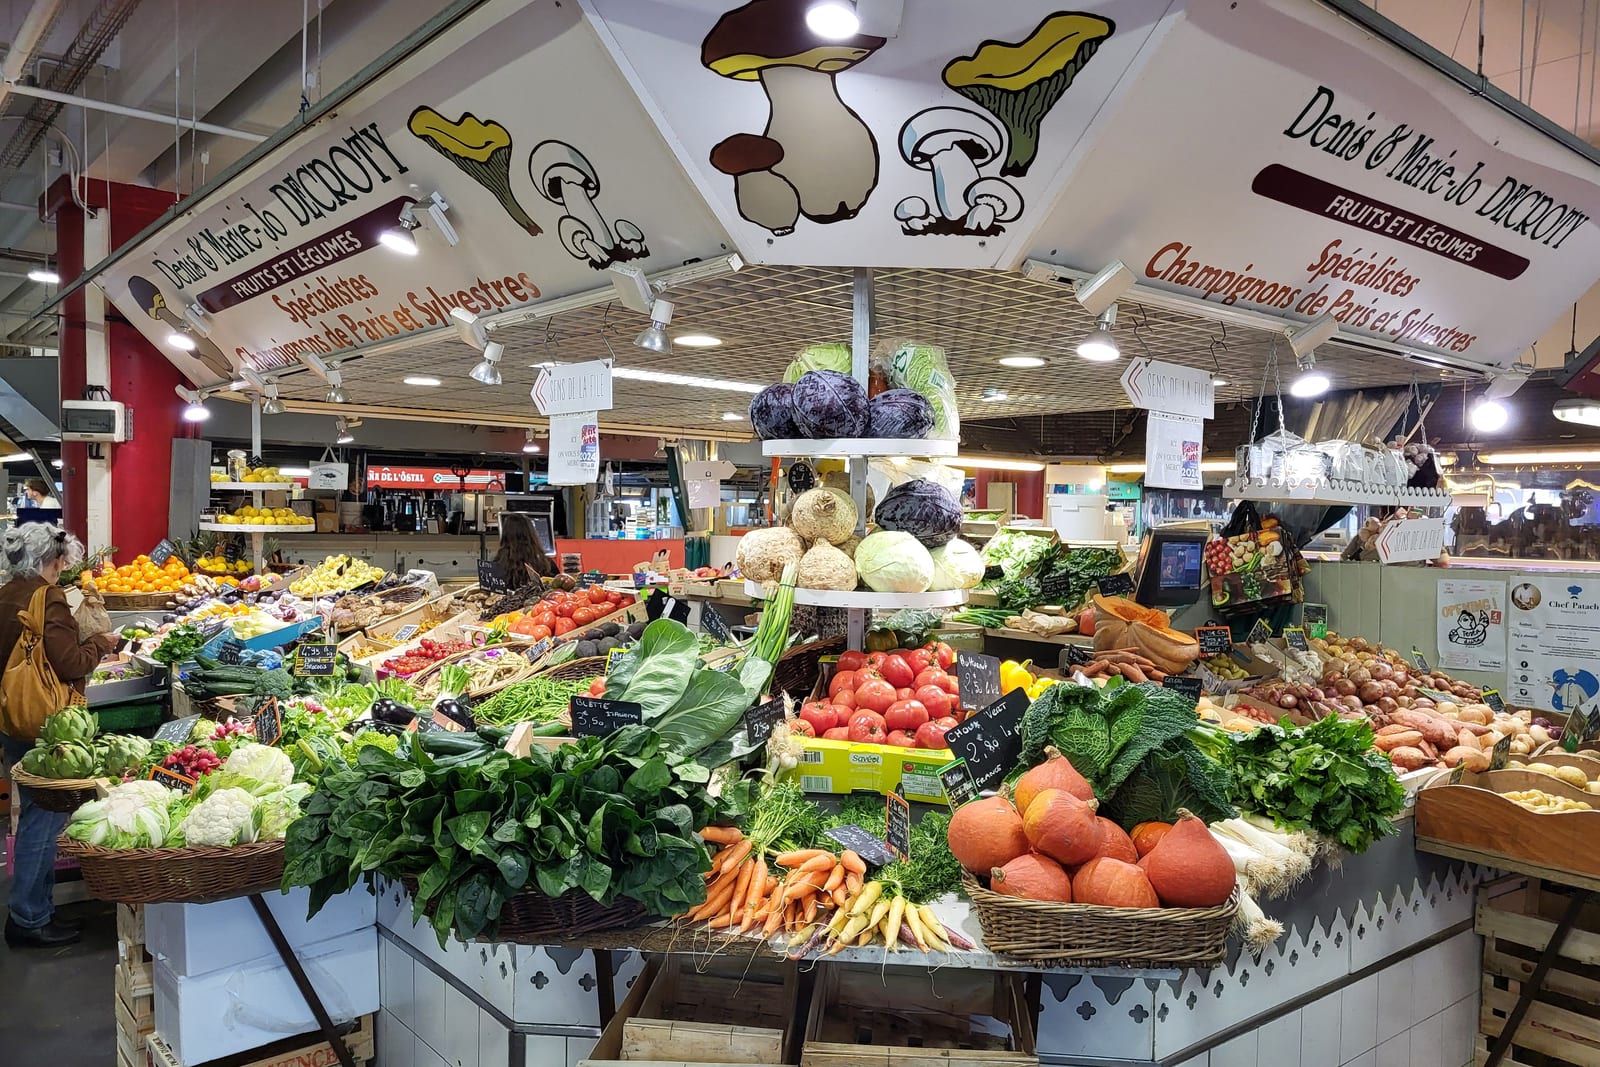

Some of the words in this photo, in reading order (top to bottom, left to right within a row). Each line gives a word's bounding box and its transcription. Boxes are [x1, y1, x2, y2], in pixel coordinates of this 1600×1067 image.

[1283, 85, 1376, 161] Denis
[1365, 124, 1413, 170] &
[270, 123, 409, 227] DECROTY
[1386, 134, 1485, 205] Marie-Jo
[199, 203, 287, 266] Marie-Jo
[1325, 195, 1391, 229] FRUITS
[1384, 216, 1415, 235] ET
[1408, 225, 1483, 262] LÉGUMES
[1475, 176, 1590, 249] DECROTY
[153, 249, 207, 289] Denis
[187, 236, 218, 272] &
[231, 268, 278, 298] FRUITS
[272, 259, 296, 280] ET
[291, 230, 362, 271] LÉGUMES
[1307, 239, 1421, 297] Spécialistes
[272, 274, 378, 328] Spécialistes
[393, 302, 425, 331] et
[407, 272, 542, 327] Sylvestres
[1145, 242, 1302, 309] Champignons
[1295, 284, 1329, 316] de
[1326, 289, 1378, 328] Paris
[1370, 310, 1402, 333] et
[1390, 308, 1478, 352] Sylvestres
[320, 321, 354, 347] de
[337, 307, 400, 343] Paris
[550, 377, 566, 402] SENS
[568, 376, 576, 400] DE
[1548, 600, 1569, 609] Chef
